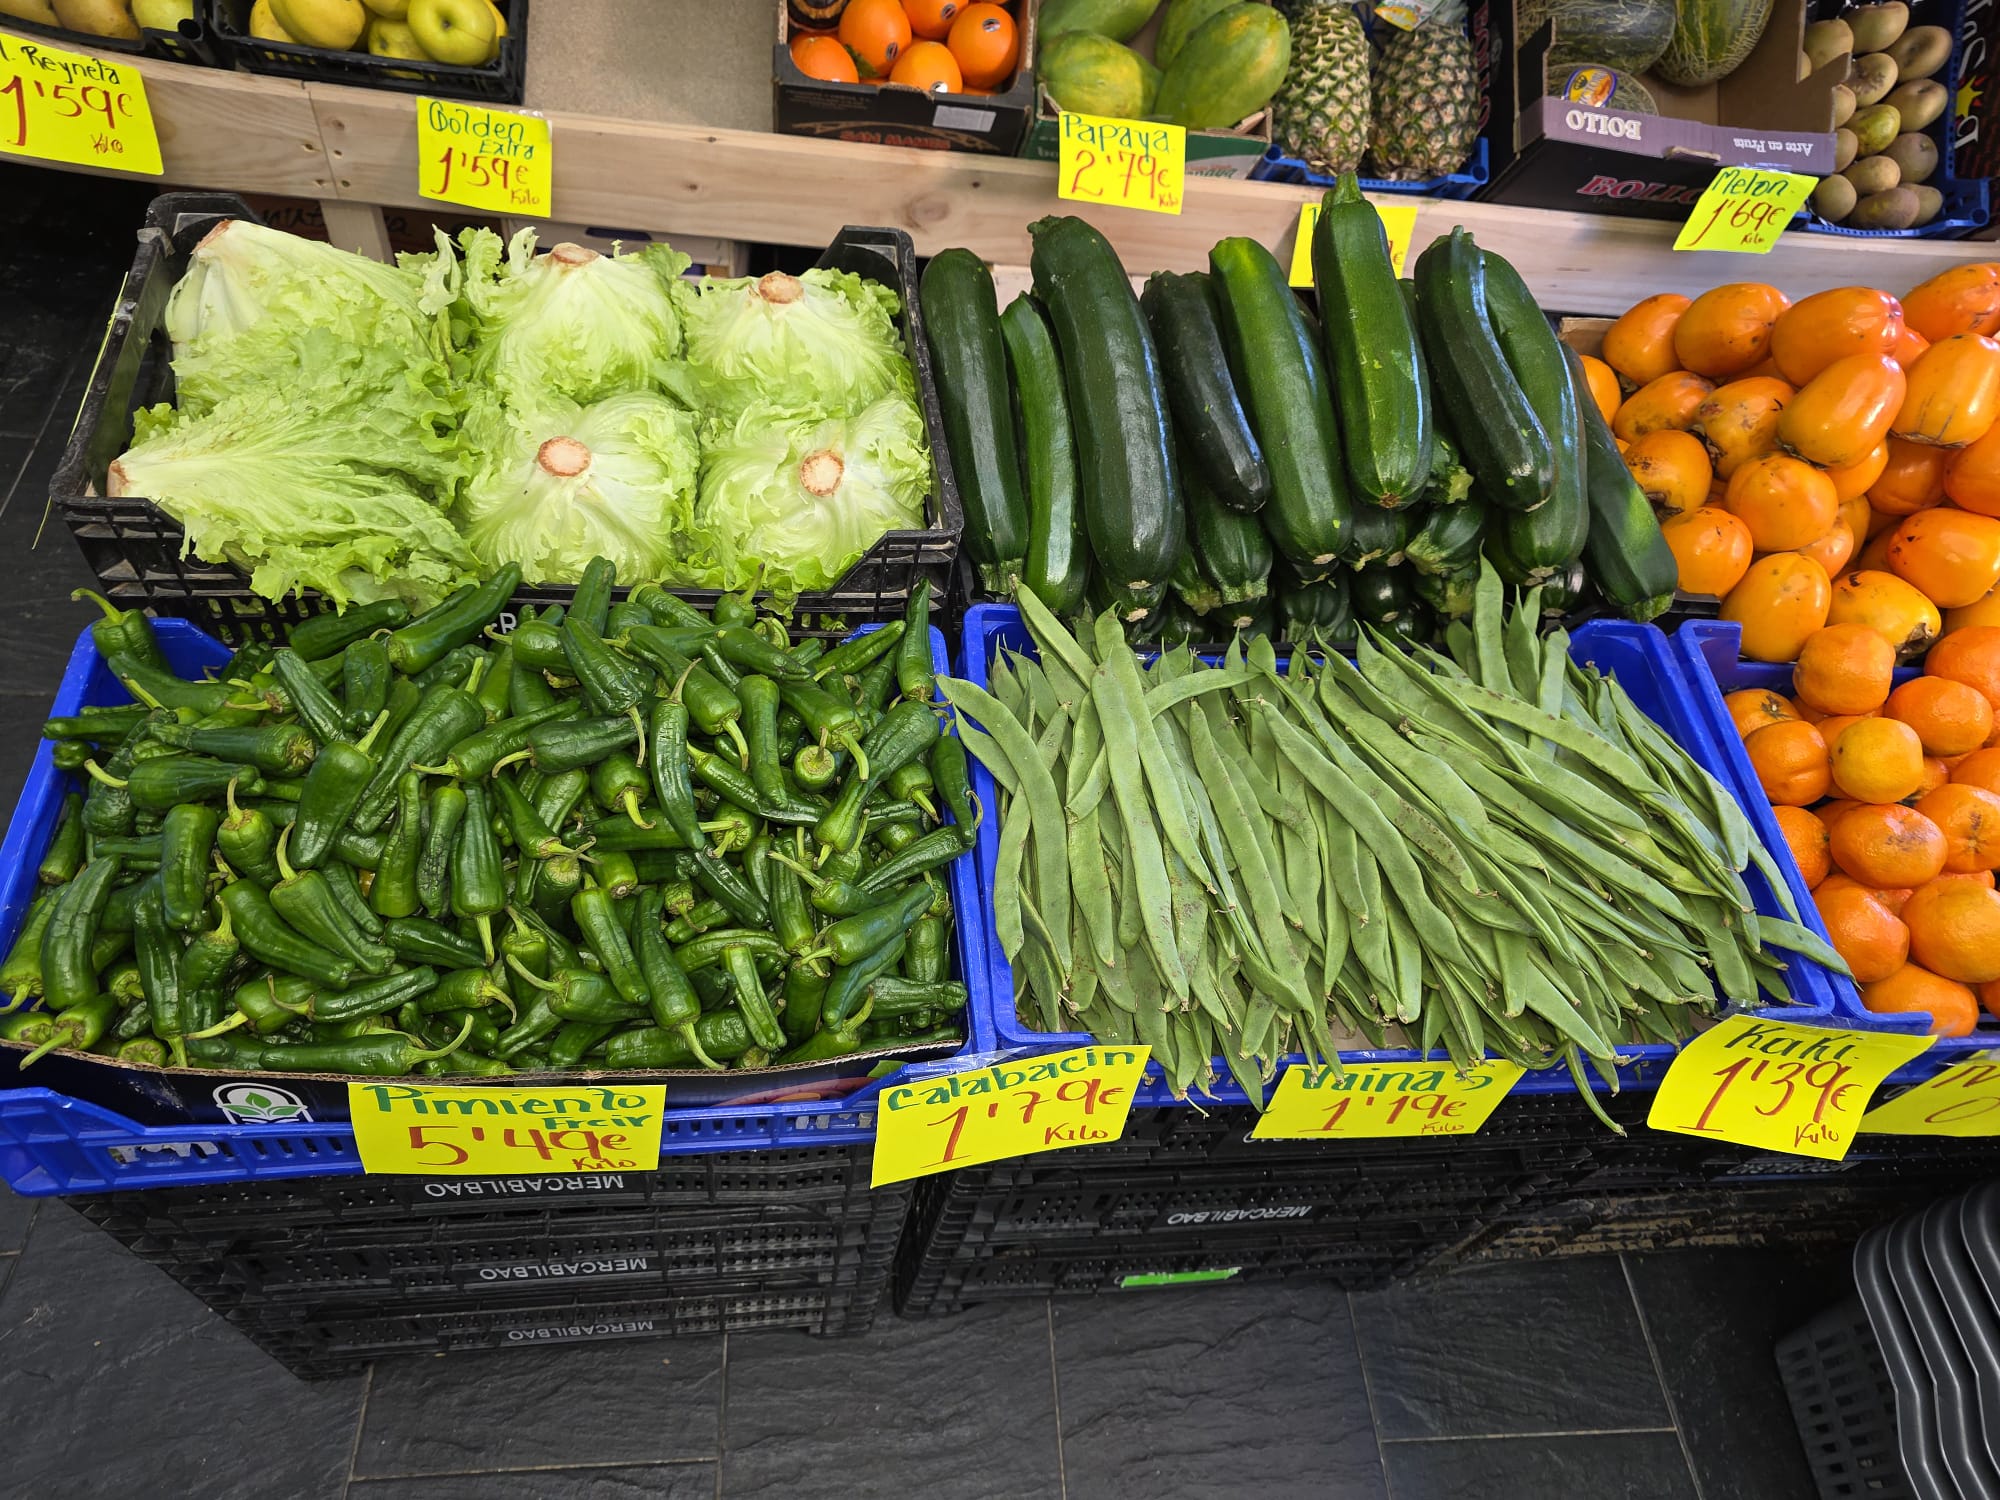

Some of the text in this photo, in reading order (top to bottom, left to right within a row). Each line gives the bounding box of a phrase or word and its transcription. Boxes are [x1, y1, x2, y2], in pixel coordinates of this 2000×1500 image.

[20, 46, 120, 85] Reyneta
[429, 101, 524, 142] Golden
[1063, 114, 1170, 163] Papaya
[1565, 110, 1642, 140] BOLLO
[430, 147, 529, 195] 1'59€
[1071, 150, 1171, 200] 2'79€
[1712, 169, 1789, 197] Melon
[1687, 199, 1786, 247] 1'69€
[362, 1085, 646, 1116] Pimiento
[1677, 1057, 1863, 1132] 1'39€
[920, 1079, 1125, 1168] 1'79€
[1297, 1094, 1467, 1133] 1'19€
[1044, 1123, 1108, 1145] Kilo
[572, 1157, 637, 1170] Kilo
[425, 1175, 624, 1197] MERCABILBAO
[1167, 1205, 1313, 1225] MERCABILBAO
[480, 1257, 648, 1280] MERCABILBAO
[508, 1320, 654, 1341] MERCABILBAO
